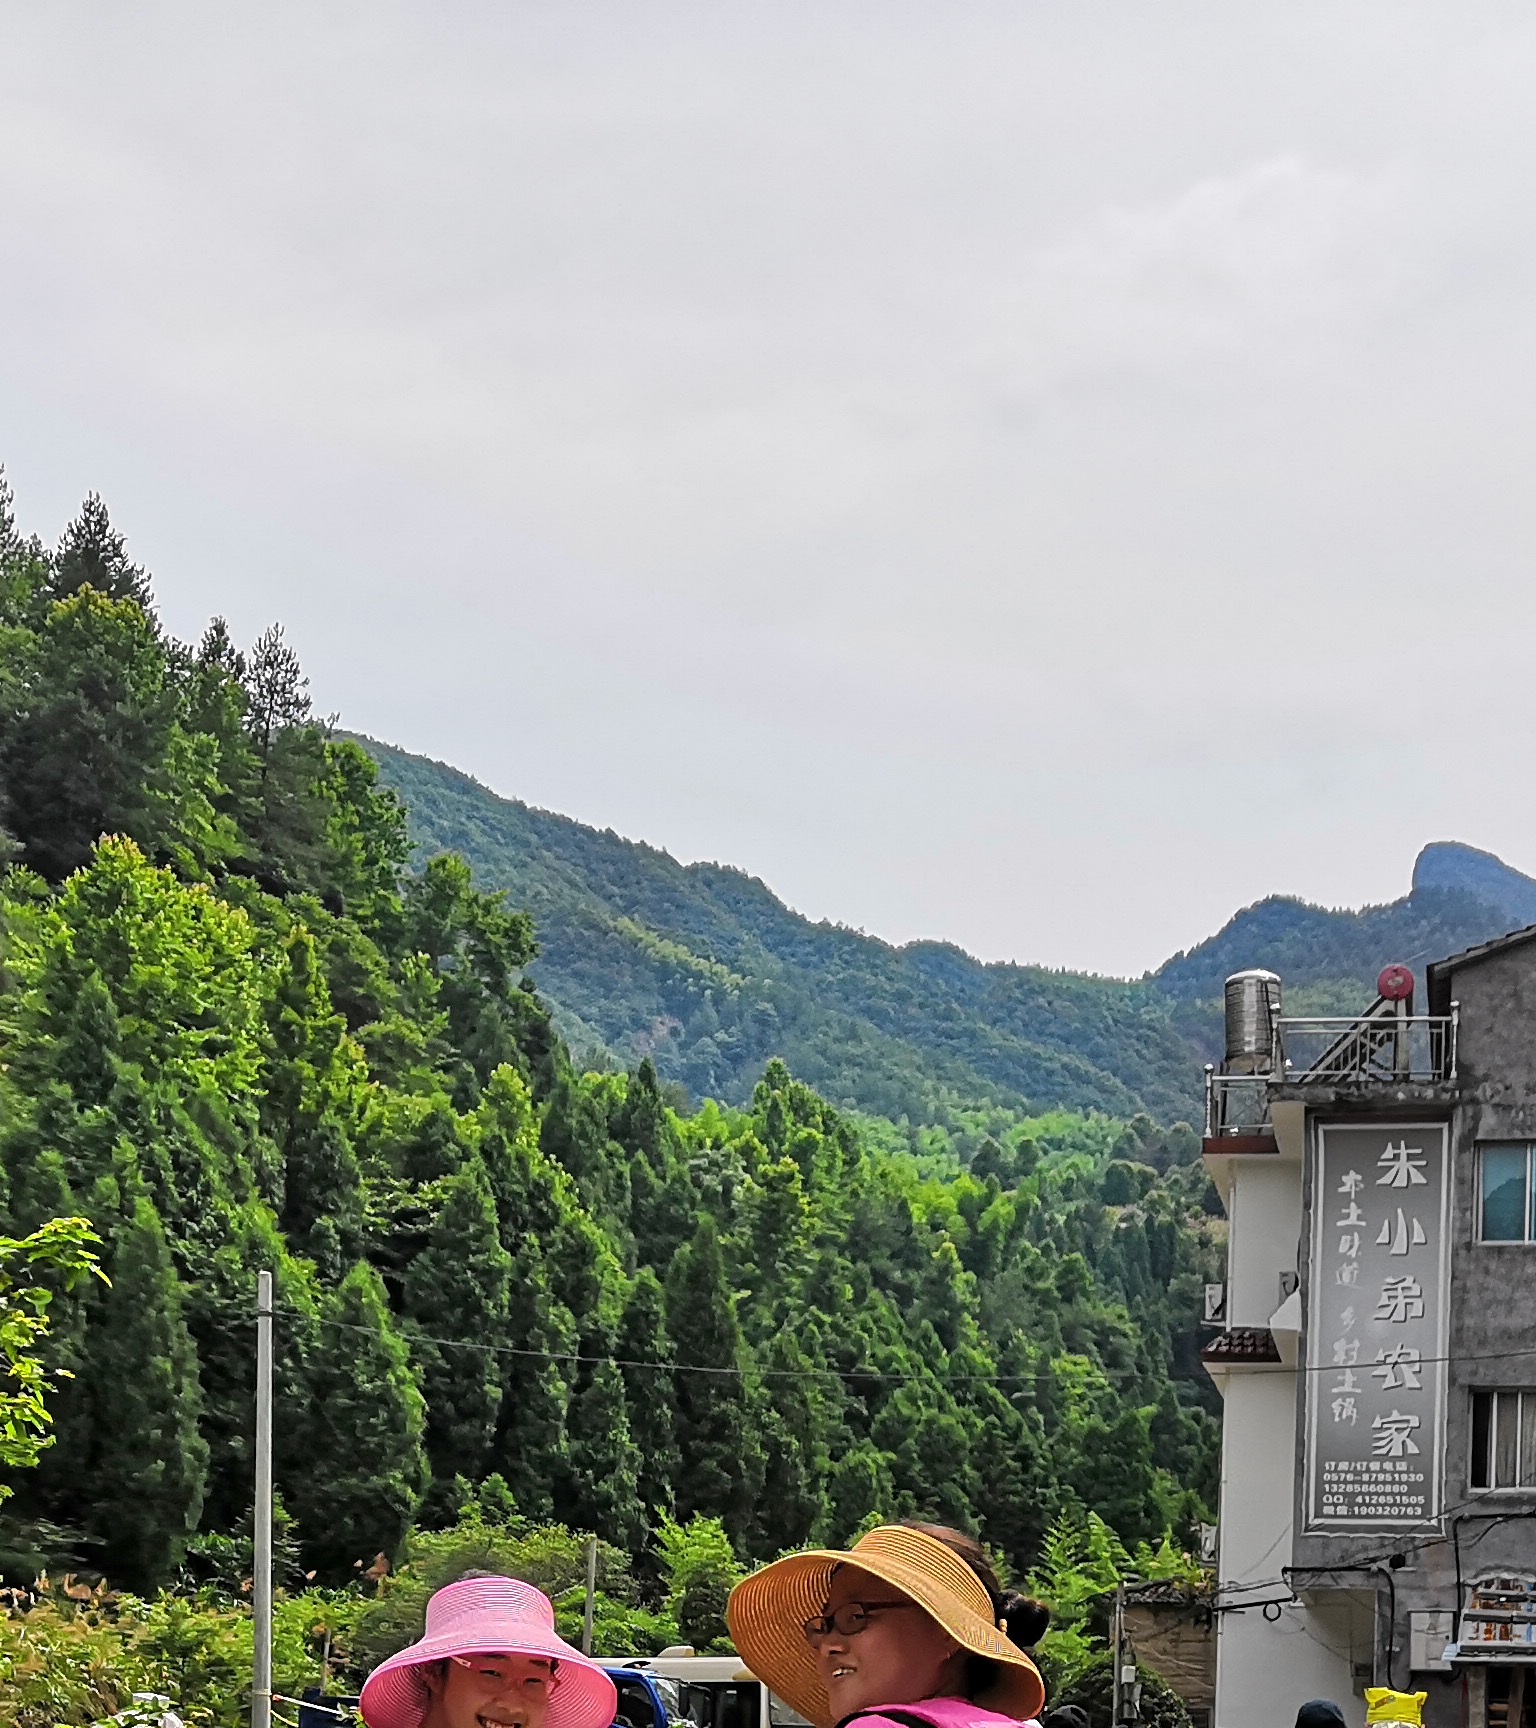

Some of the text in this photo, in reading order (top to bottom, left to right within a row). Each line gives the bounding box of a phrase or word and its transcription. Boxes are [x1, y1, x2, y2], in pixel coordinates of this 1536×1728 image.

[1371, 1139, 1428, 1457] 朱小弟农家
